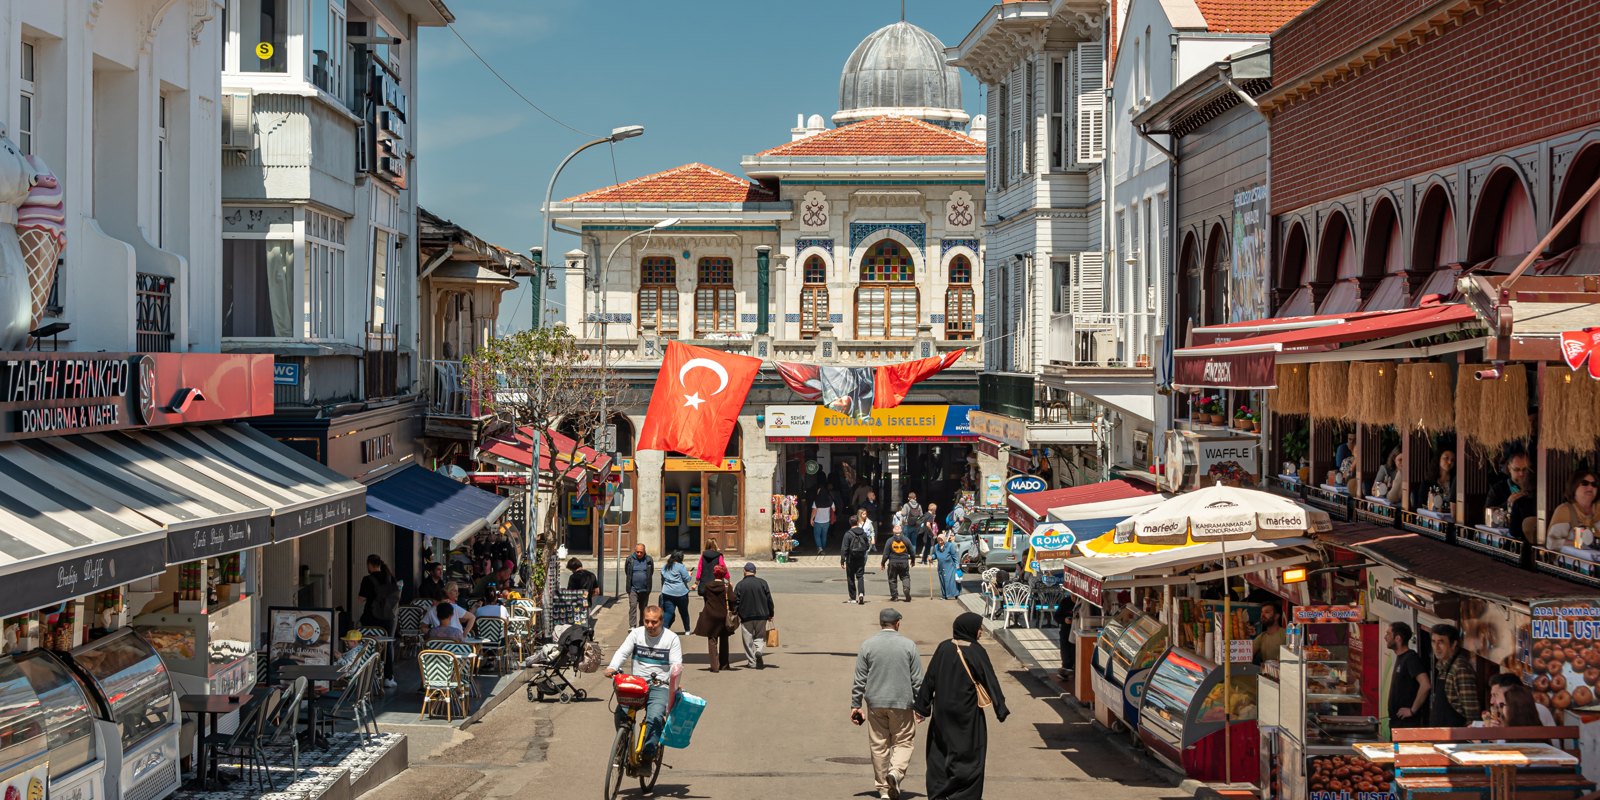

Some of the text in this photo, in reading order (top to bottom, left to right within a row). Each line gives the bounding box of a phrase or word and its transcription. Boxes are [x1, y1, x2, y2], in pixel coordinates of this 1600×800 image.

[260, 43, 269, 54] S
[274, 366, 294, 375] WC
[22, 403, 120, 433] DONDURMA & WAFFLE
[887, 414, 936, 427] İSKELESİ
[1205, 448, 1249, 459] WAFFLE
[1010, 481, 1041, 490] MADO
[1266, 516, 1302, 526] marfedo
[1143, 521, 1179, 534] marfedo
[1036, 536, 1069, 545] ROMA
[1375, 579, 1393, 605] Garanti
[1298, 610, 1324, 618] SICAK
[1533, 607, 1554, 616] ADA
[1532, 616, 1572, 639] HALİL
